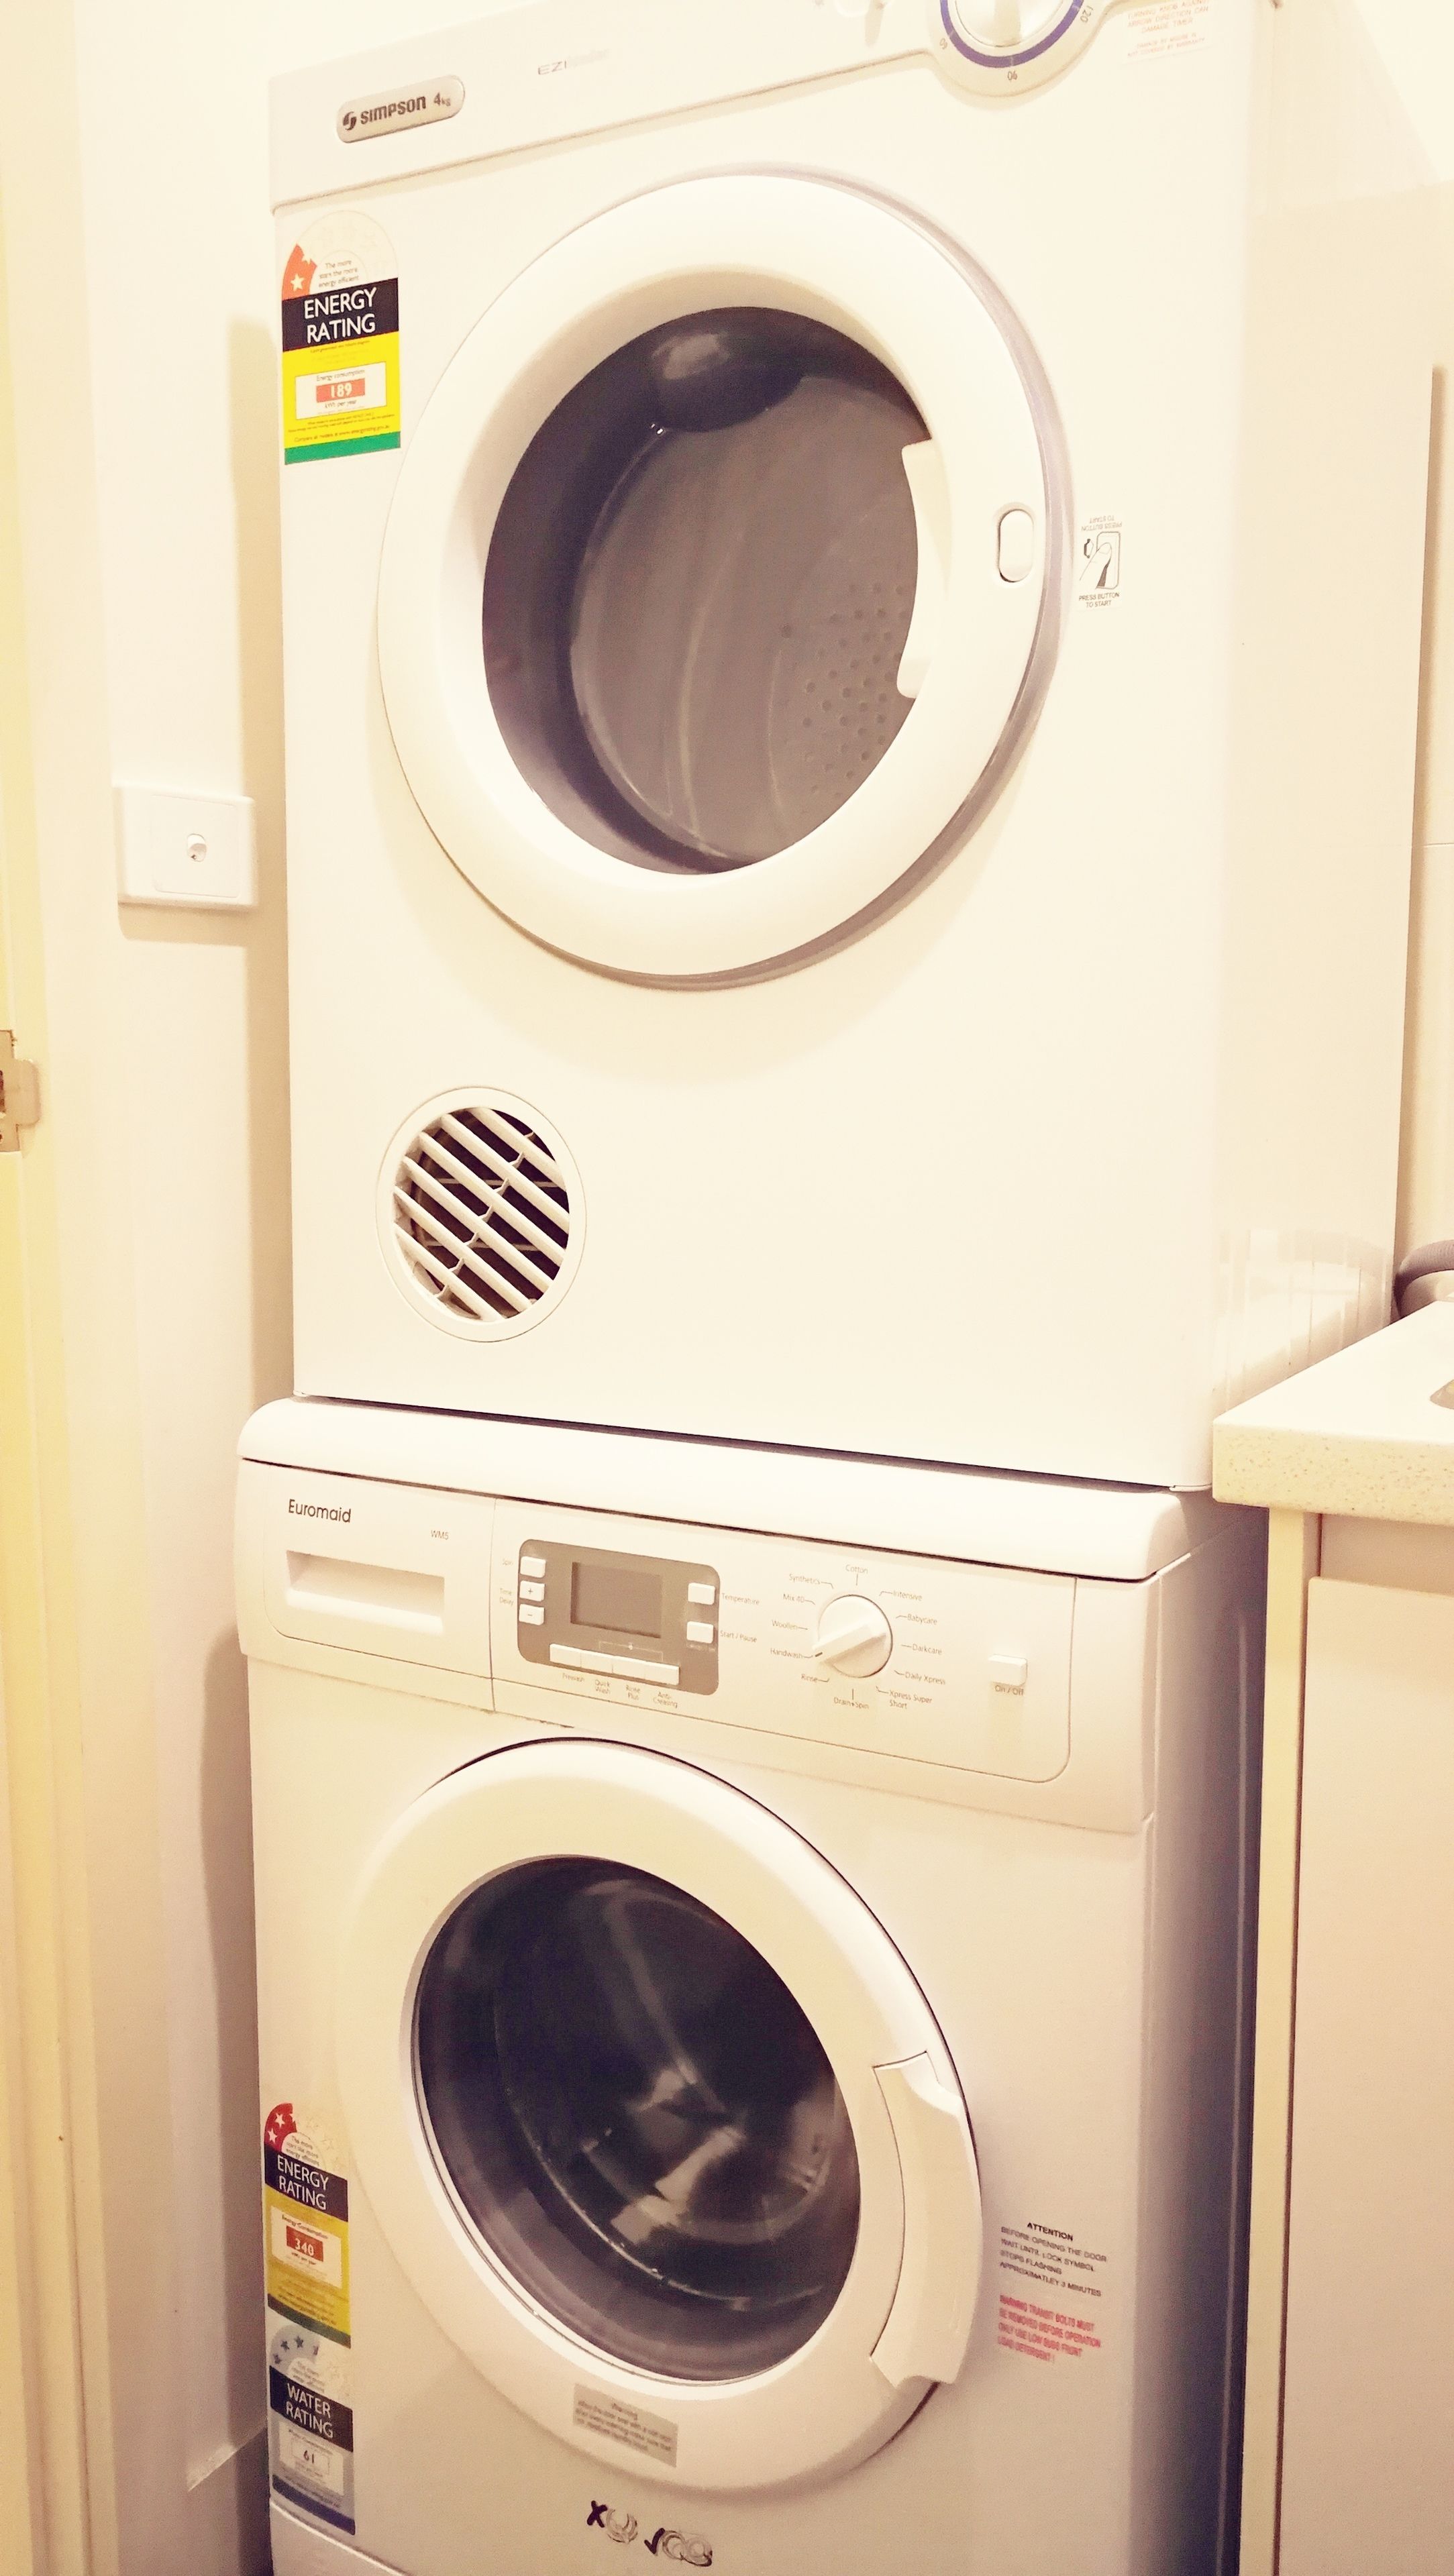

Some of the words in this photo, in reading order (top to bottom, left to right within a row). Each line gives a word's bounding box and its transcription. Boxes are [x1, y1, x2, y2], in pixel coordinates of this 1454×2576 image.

[360, 95, 426, 125] SIMPSON
[304, 287, 377, 319] ENERGY
[307, 313, 376, 343] RATING
[330, 382, 352, 398] 189
[289, 1499, 351, 1523] Euromaid
[430, 1529, 450, 1540] WM5
[845, 1564, 868, 1574] Cotton
[789, 1573, 821, 1585] Synthetics
[722, 1593, 760, 1605] Temperature
[783, 1593, 794, 1601] Mix
[893, 1591, 923, 1601] Intensive
[772, 1619, 798, 1629] Woollen
[907, 1613, 937, 1625] Babycare
[720, 1629, 734, 1639] Start
[740, 1633, 758, 1643] Pause
[770, 1648, 803, 1658] Handwash
[913, 1644, 942, 1655] Darkcare
[801, 1674, 818, 1682] Rinse
[905, 1671, 922, 1681] Daily
[923, 1674, 945, 1685] Xpress
[890, 1690, 911, 1701] Xpress
[913, 1694, 932, 1704] Super
[995, 1684, 1005, 1693] On
[1012, 1686, 1024, 1696] Off
[890, 1699, 907, 1709] Short
[278, 2154, 329, 2190] ENERGY
[279, 2176, 326, 2210] RATING
[1027, 2222, 1074, 2241] ATTENTION
[295, 2238, 314, 2256] 340
[1001, 2226, 1029, 2241] BEFORE
[1032, 2237, 1066, 2252] OPENING
[1068, 2246, 1082, 2255] THE
[1084, 2251, 1106, 2262] DOOR
[1001, 2238, 1018, 2248] WAIT
[1020, 2245, 1039, 2256] UNTIL
[1043, 2253, 1061, 2263] LOCK
[1064, 2258, 1094, 2271] SYMBOL
[1000, 2249, 1024, 2262] STOPS
[1025, 2258, 1062, 2275] FLASHING
[1068, 2283, 1101, 2297] MINUTES
[287, 2383, 331, 2418] WATER
[286, 2401, 333, 2438] RATING
